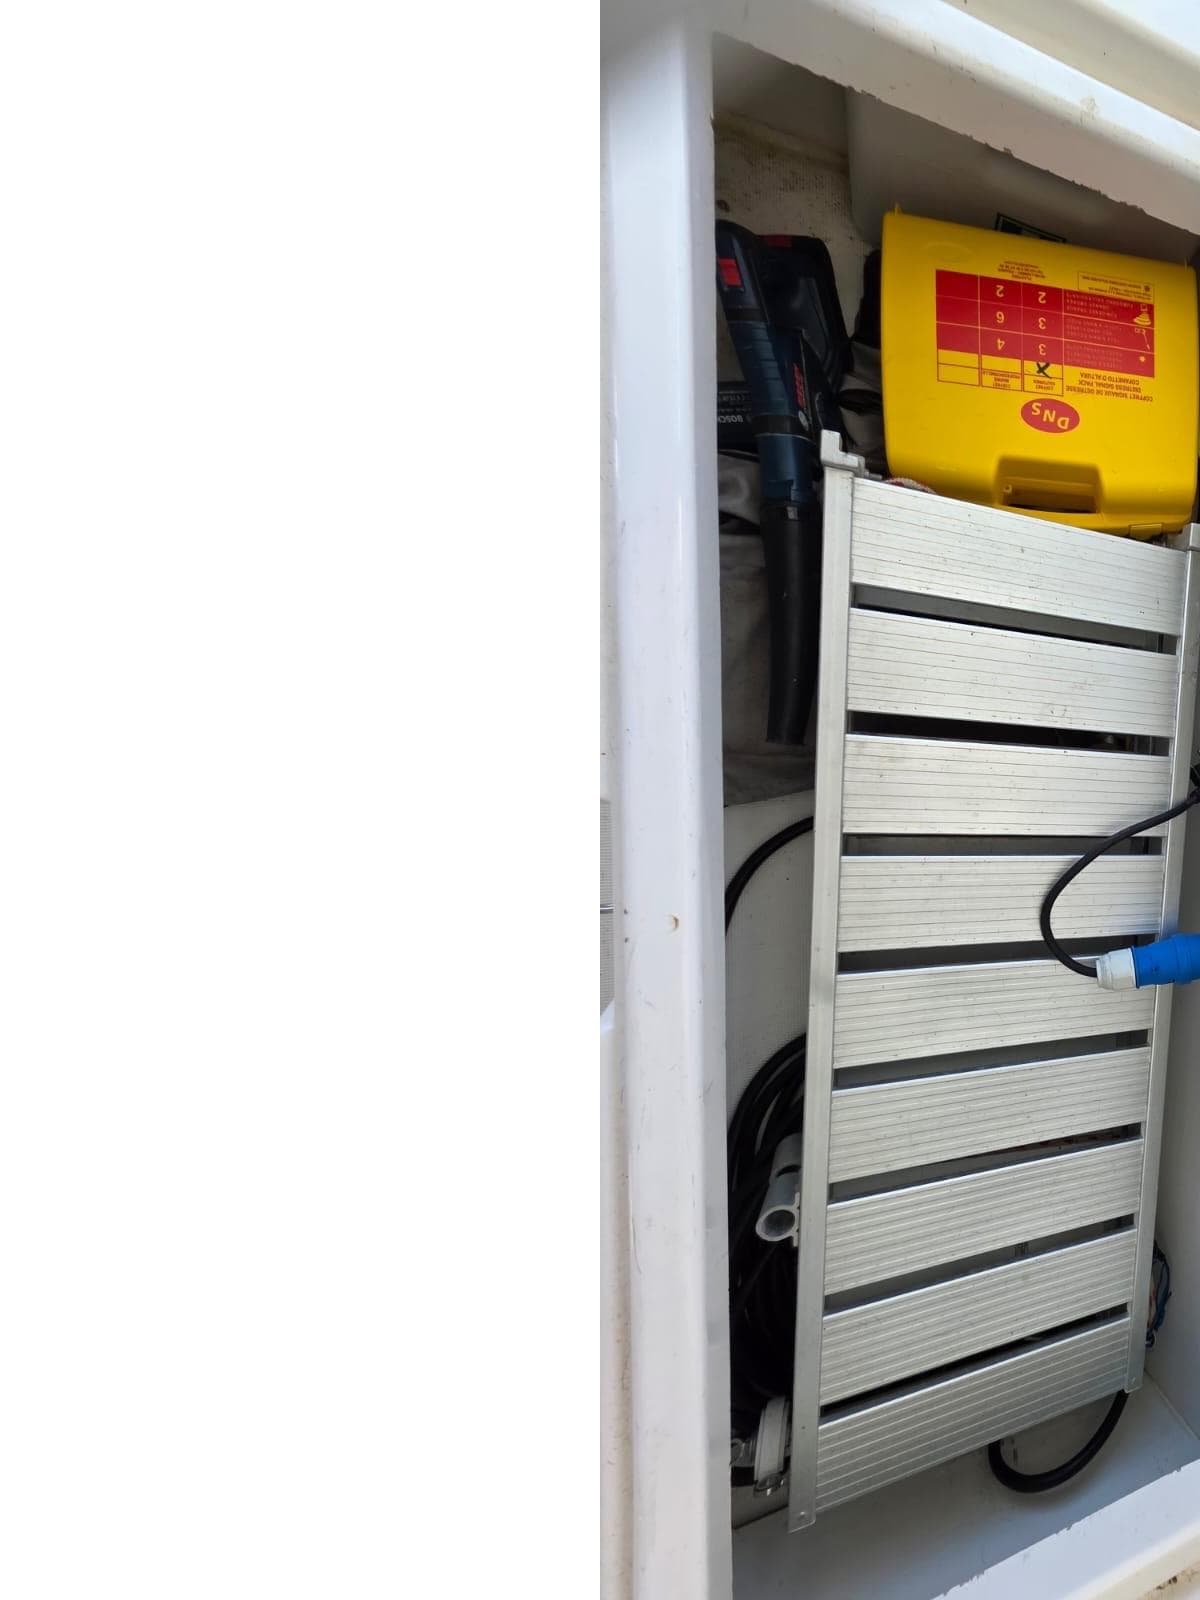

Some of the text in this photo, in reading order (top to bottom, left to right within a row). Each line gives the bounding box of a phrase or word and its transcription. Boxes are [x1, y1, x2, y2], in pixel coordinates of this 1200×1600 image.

[995, 285, 1005, 298] 2
[1038, 291, 1047, 304] 2
[996, 311, 1005, 324] 6
[1038, 317, 1047, 330] 3
[996, 338, 1006, 351] 4
[1038, 343, 1046, 356] 3
[1031, 402, 1070, 430] DNS
